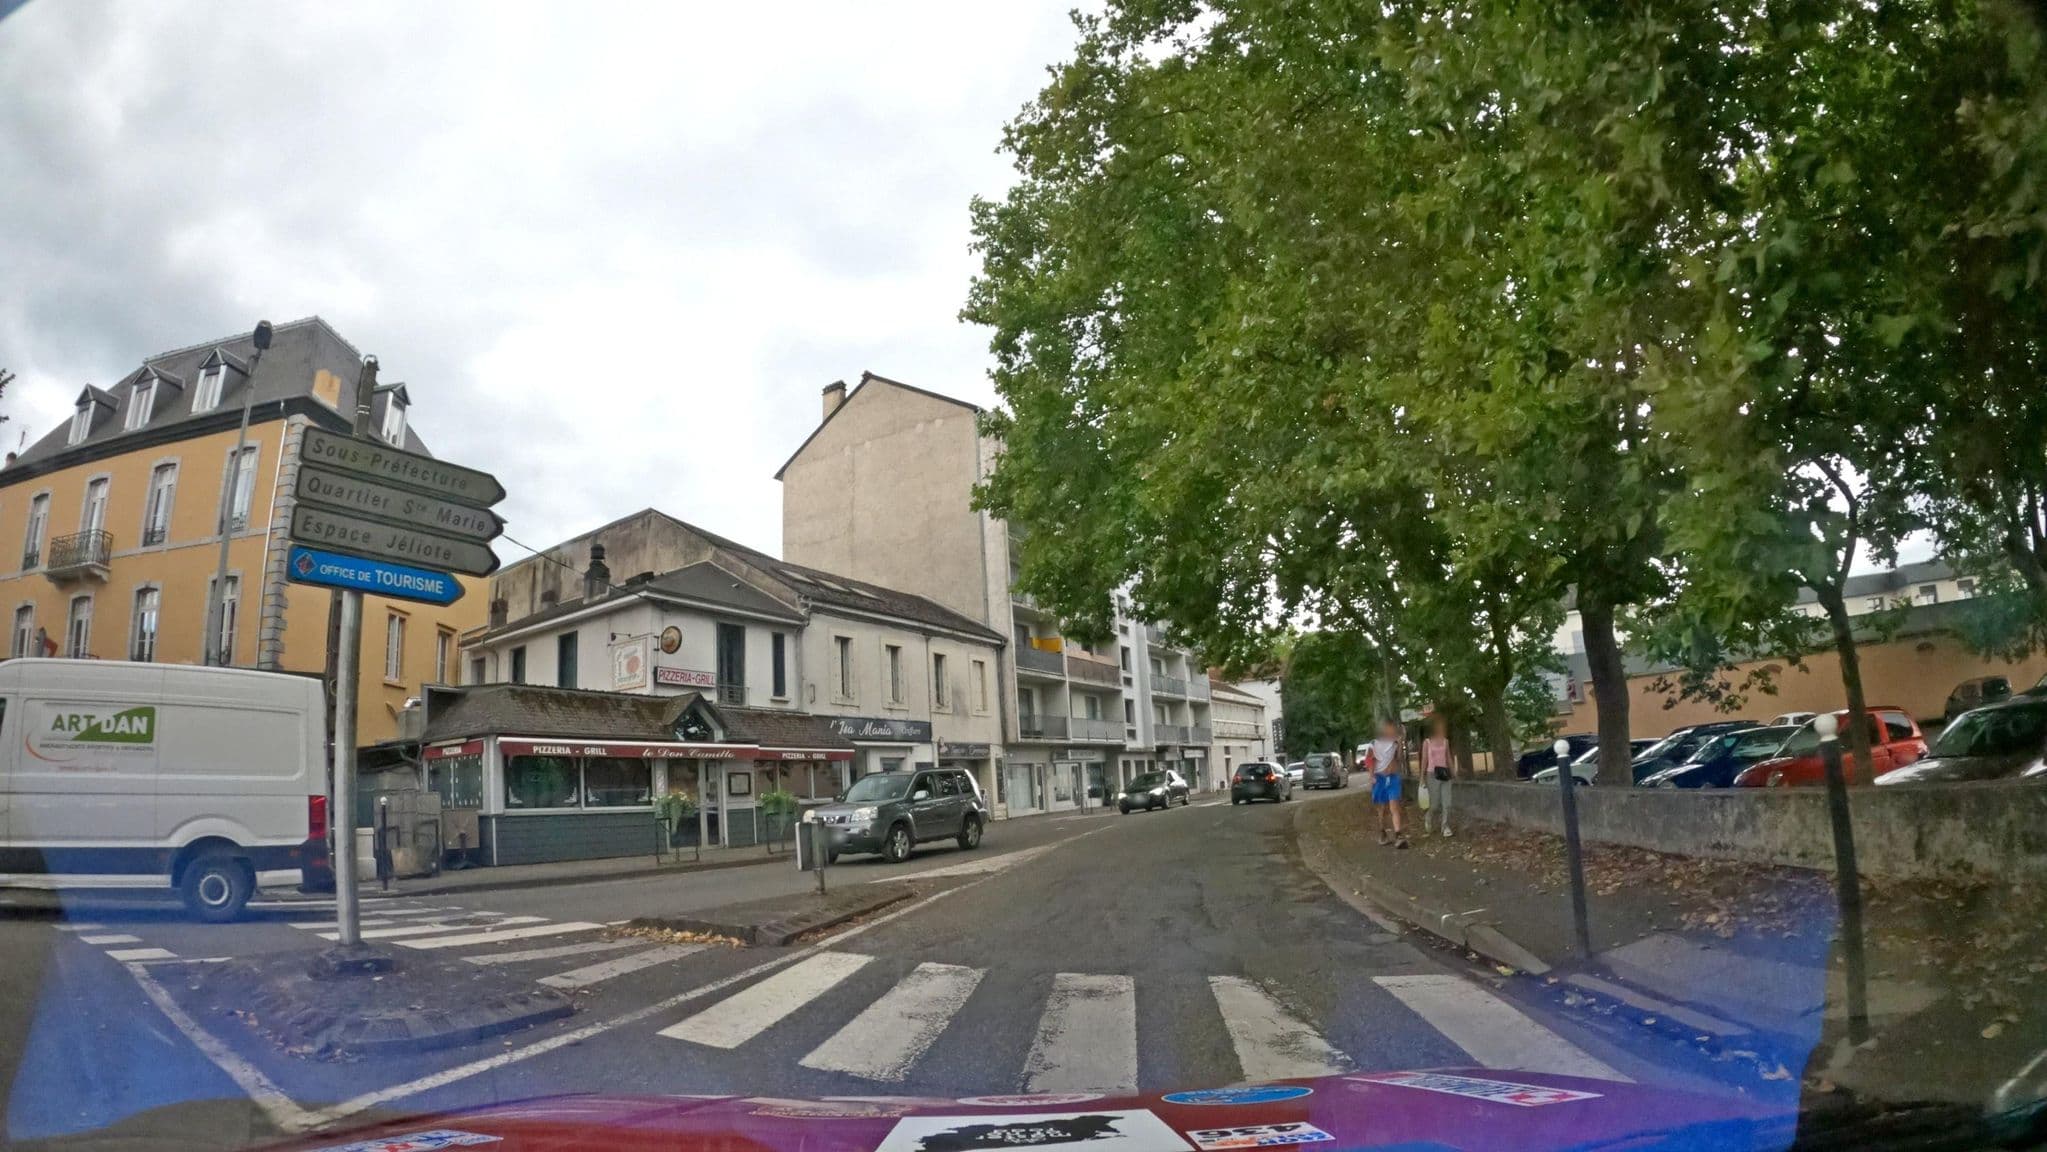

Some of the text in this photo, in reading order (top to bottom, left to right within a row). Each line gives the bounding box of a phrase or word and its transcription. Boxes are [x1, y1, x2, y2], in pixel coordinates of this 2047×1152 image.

[307, 477, 389, 510] Quartier
[436, 509, 485, 532] Marie
[302, 515, 452, 560] Espace Jéliote
[320, 564, 444, 594] OFFICE DE TOURISME
[859, 722, 892, 736] Mania
[532, 745, 572, 755] PIZZERIA
[584, 746, 607, 756] GRILL
[657, 747, 683, 758] Don
